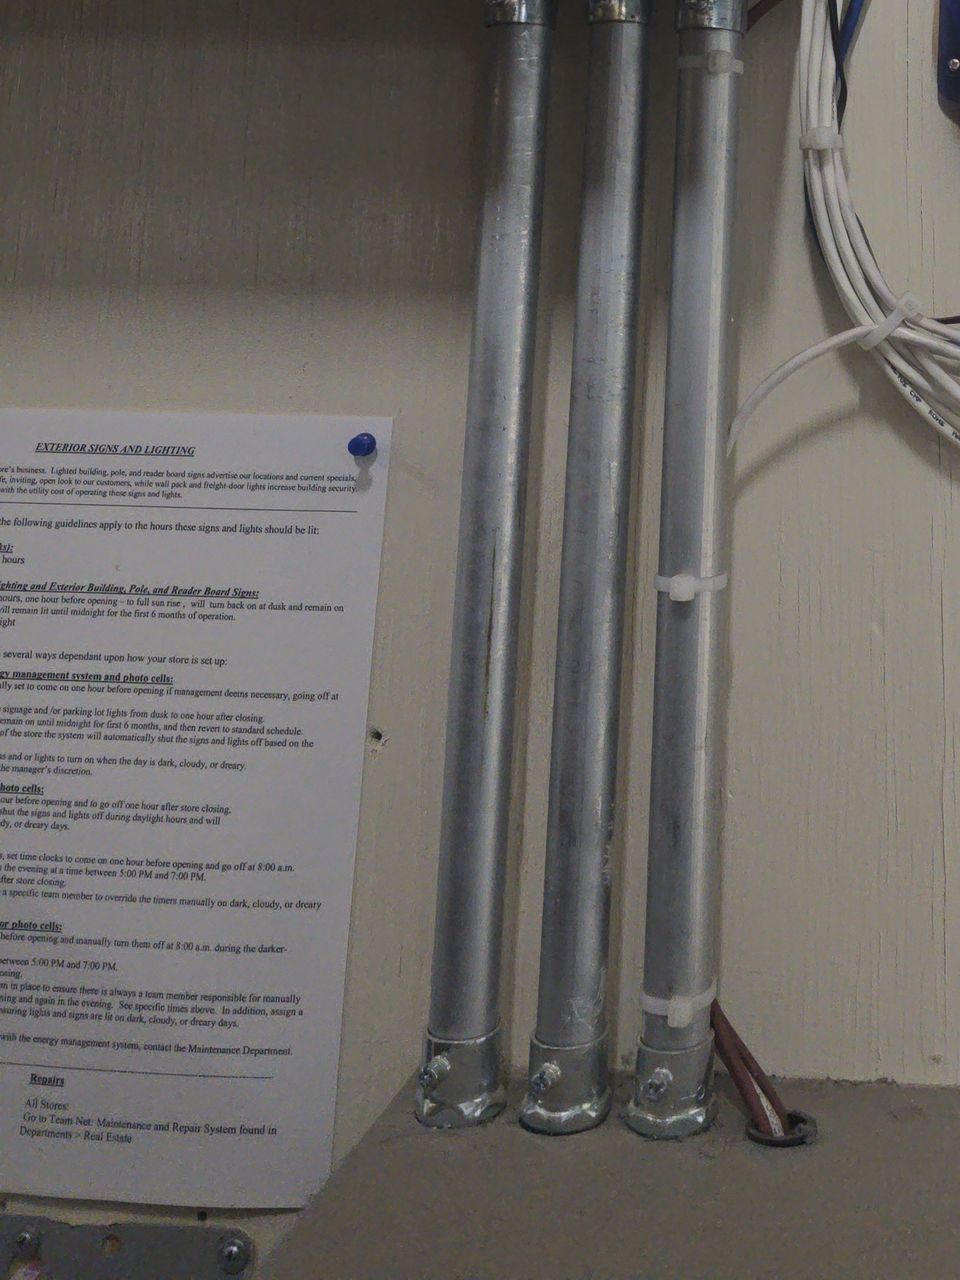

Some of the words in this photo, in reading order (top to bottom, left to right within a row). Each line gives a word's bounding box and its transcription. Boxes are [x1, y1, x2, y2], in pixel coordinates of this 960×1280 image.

[35, 442, 86, 453] EXTERIOR
[88, 444, 118, 454] SIGNS
[120, 445, 143, 455] AND
[144, 445, 196, 457] LIGHTING
[16, 466, 46, 474] business.
[50, 467, 77, 477] Lighted
[78, 467, 108, 478] building,
[110, 468, 127, 478] pole,
[142, 469, 164, 477] reader
[165, 469, 186, 477] board
[186, 470, 205, 480] signs
[206, 470, 238, 479] advertise
[252, 471, 284, 480] locations
[299, 472, 324, 481] current
[326, 473, 356, 483] specials,
[28, 486, 49, 496] utility
[74, 487, 107, 498] operating
[108, 488, 126, 496] these
[128, 489, 145, 499] signs
[161, 490, 182, 500] lights.
[13, 517, 52, 529] following
[54, 518, 97, 530] guidelines
[98, 520, 122, 531] apply
[124, 520, 133, 529] to
[134, 521, 148, 530] the
[149, 521, 173, 530] hours
[174, 522, 196, 531] these
[197, 522, 220, 534] signs
[221, 523, 237, 532] and
[238, 523, 262, 535] lights
[264, 524, 293, 533] should
[294, 525, 305, 534] be
[307, 525, 319, 534] lit:
[1, 555, 25, 564] hours
[29, 582, 47, 593] and
[48, 582, 85, 594] Exterior
[86, 583, 126, 595] Building,
[128, 584, 150, 596] Pole,
[152, 585, 169, 596] and
[170, 586, 202, 597] Reader
[203, 586, 231, 598] Board
[231, 587, 259, 598] Signs:
[2, 649, 32, 659] several
[35, 653, 56, 662] ways
[58, 651, 101, 663] dependant
[104, 655, 124, 664] upon
[126, 653, 145, 662] how
[147, 656, 166, 665] your
[168, 654, 189, 664] store
[191, 655, 198, 664] is
[200, 656, 212, 664] set
[214, 656, 227, 667] up:
[11, 669, 69, 682] management
[71, 671, 102, 682] system
[103, 672, 121, 683] and
[122, 672, 149, 684] photo
[150, 673, 173, 684] cells:
[21, 784, 44, 795] cells:
[11, 920, 38, 931] photo
[39, 921, 62, 932] cells:
[29, 1073, 65, 1087] Repairs
[25, 1098, 38, 1109] All
[23, 1112, 36, 1122] Go
[38, 1114, 47, 1123] to
[50, 1114, 73, 1126] Team
[96, 1118, 151, 1131] Maintenance
[153, 1121, 170, 1131] and
[172, 1122, 201, 1135] Repair
[204, 1123, 236, 1136] System
[239, 1124, 265, 1135] found
[268, 1126, 277, 1135] in
[19, 1125, 72, 1140] Departments
[84, 1130, 103, 1141] Real
[106, 1132, 132, 1144] Estate
